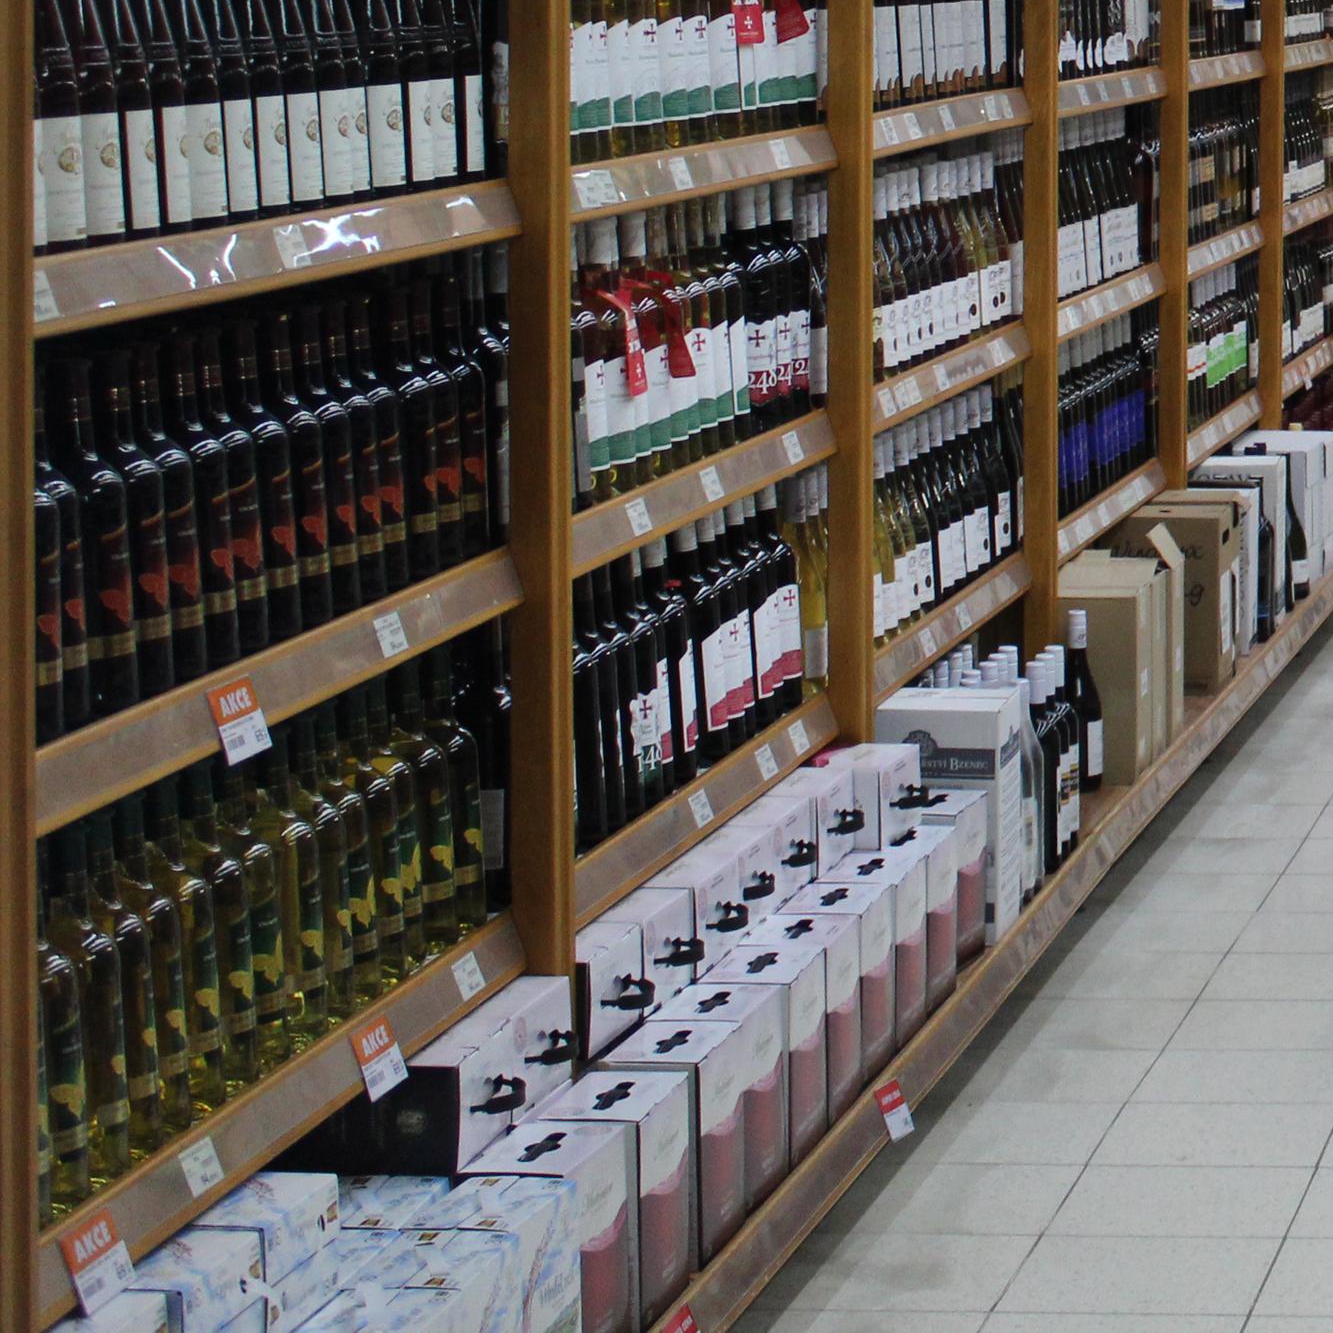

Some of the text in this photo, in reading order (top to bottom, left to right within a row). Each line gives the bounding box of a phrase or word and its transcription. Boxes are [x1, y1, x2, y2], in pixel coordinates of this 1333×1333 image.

[220, 686, 252, 718] AKCE
[362, 1024, 389, 1058] AKCE
[73, 1220, 113, 1264] AKCE
